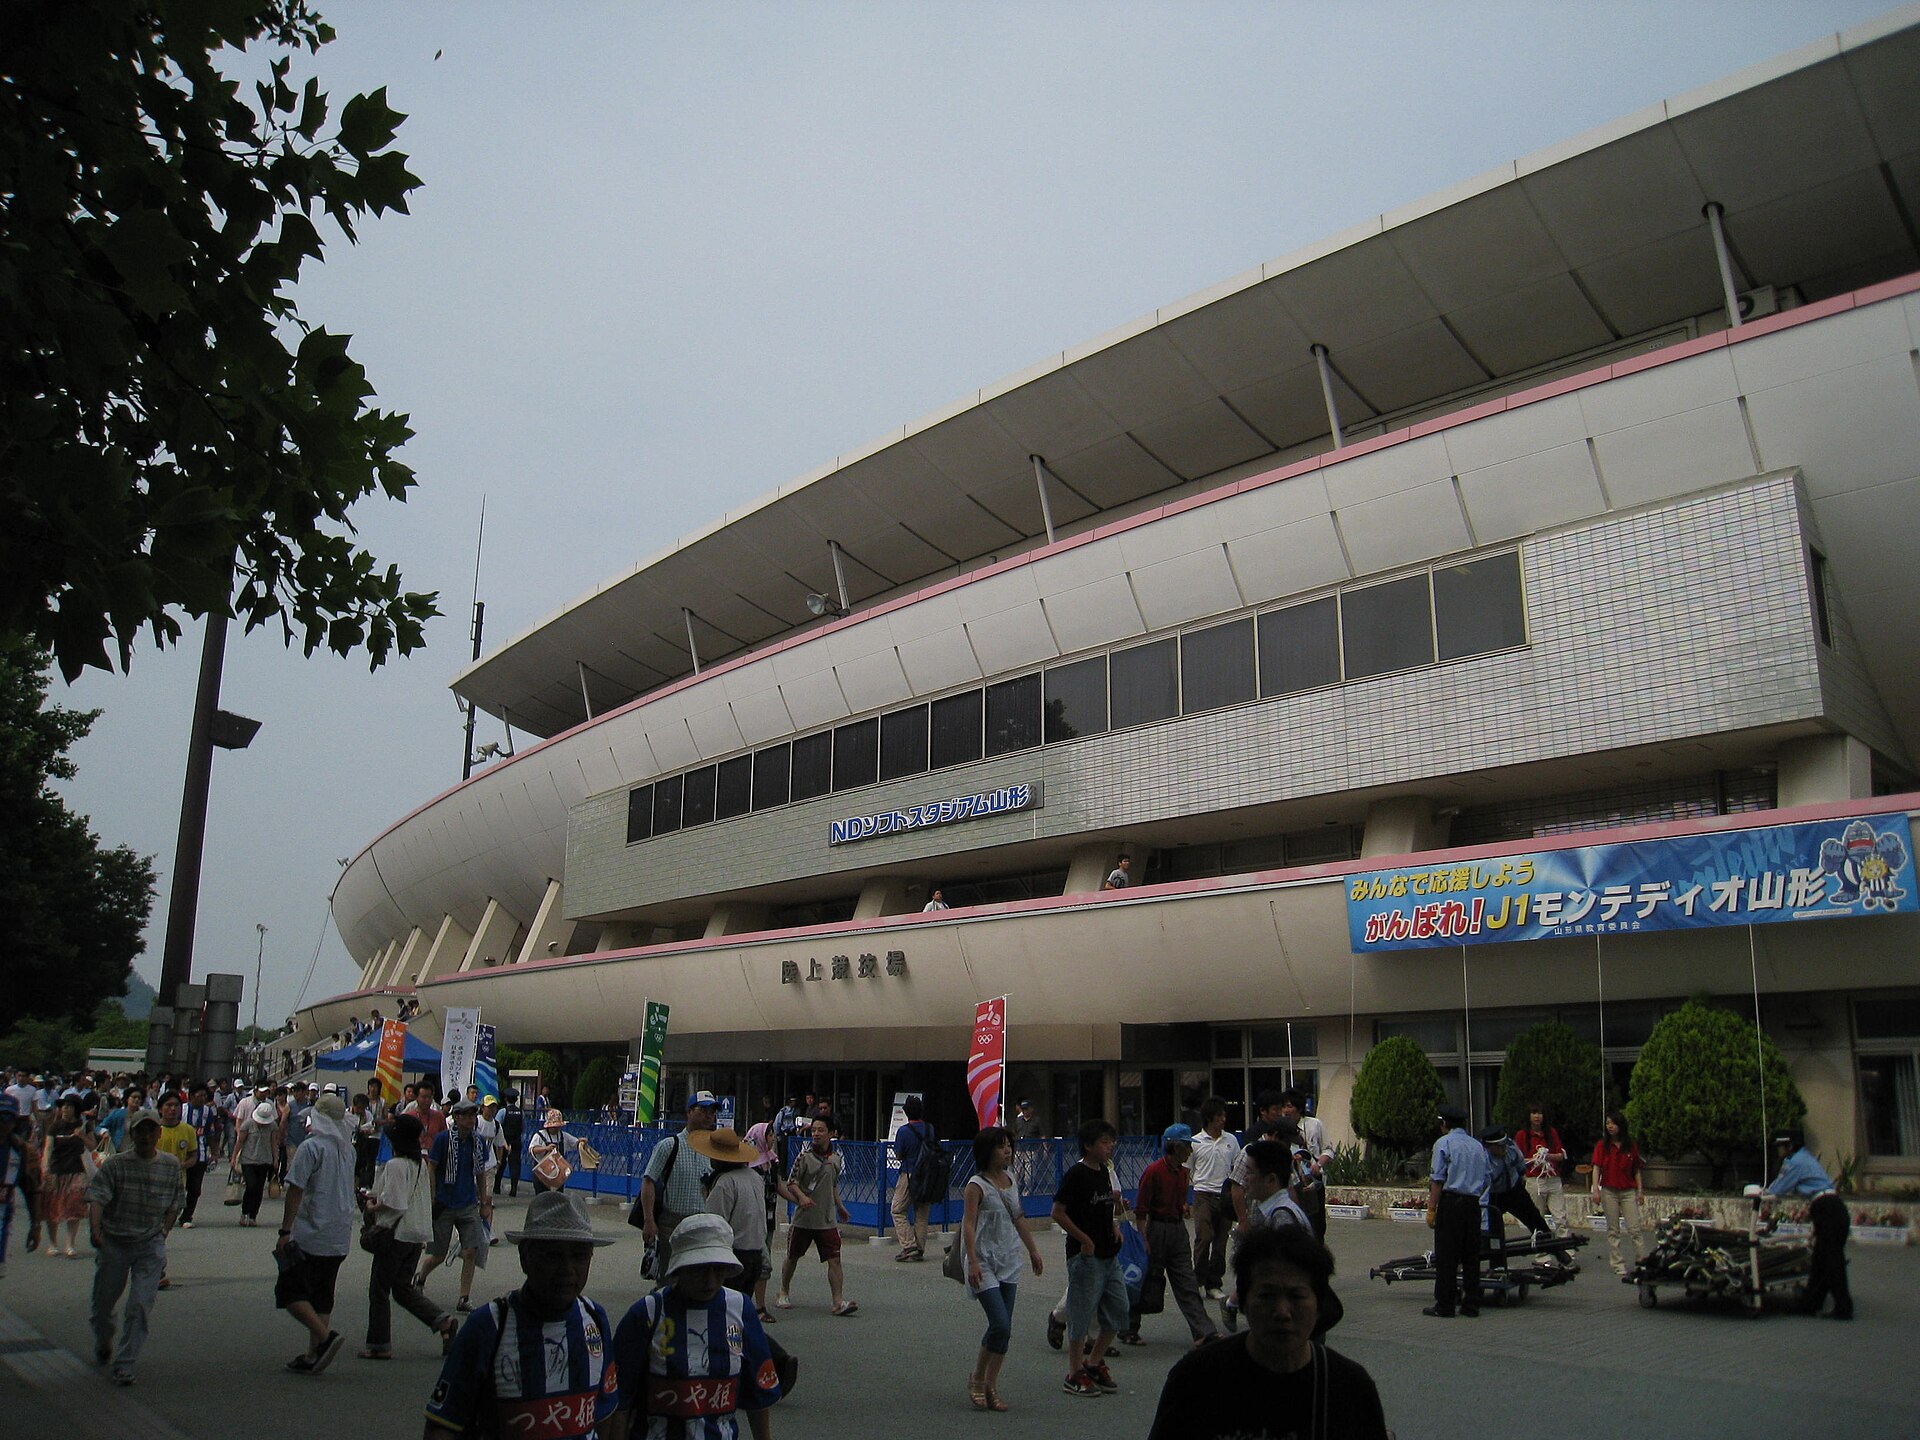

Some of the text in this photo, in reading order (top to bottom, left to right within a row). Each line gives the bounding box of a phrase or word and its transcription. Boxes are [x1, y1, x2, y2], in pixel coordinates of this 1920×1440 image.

[831, 784, 1030, 843] NDソフトスタジアム山形
[1351, 861, 1535, 901] みんなで応援しよう
[509, 1391, 599, 1433] つや姫
[654, 1382, 732, 1411] つや姫
